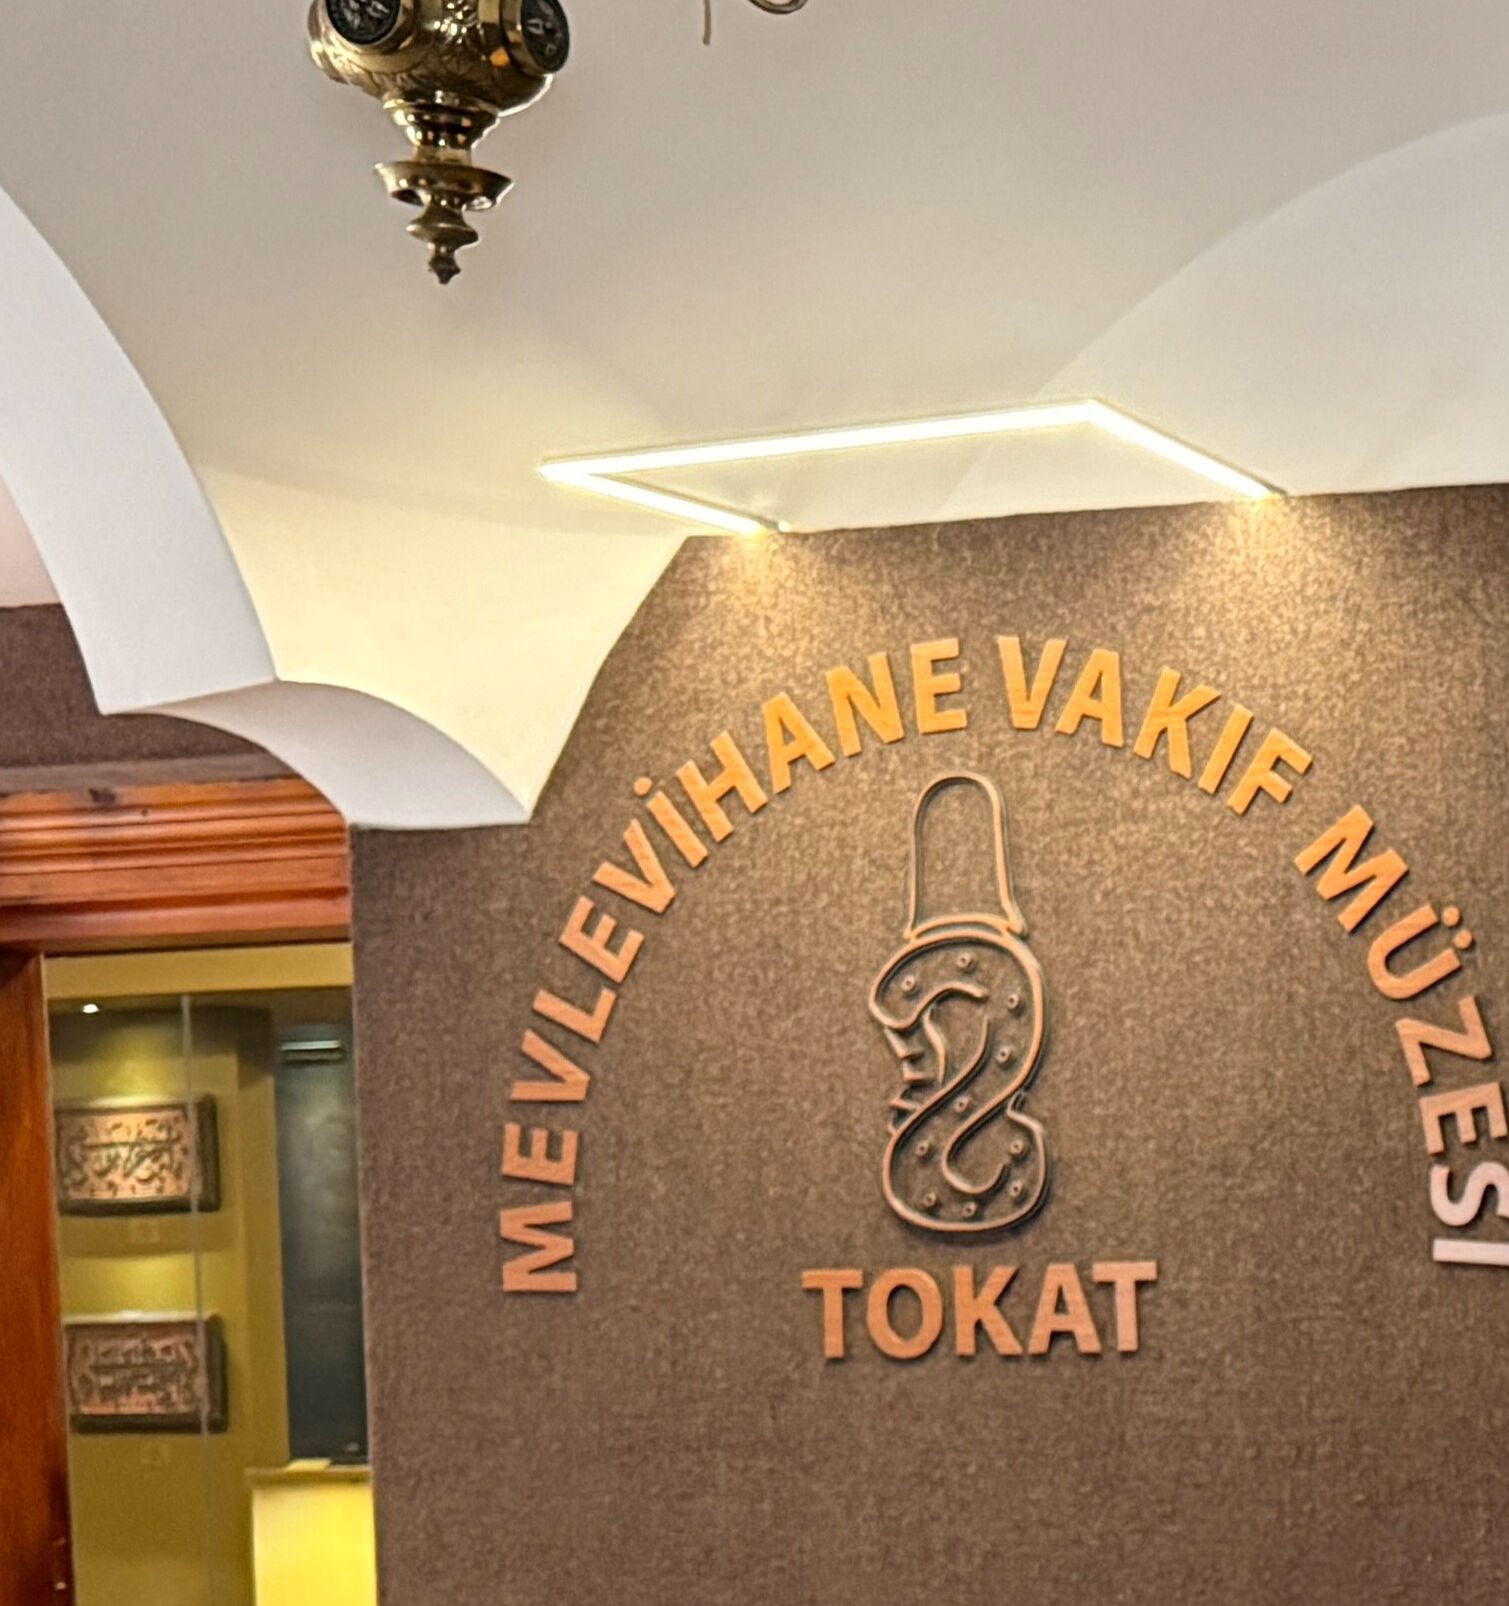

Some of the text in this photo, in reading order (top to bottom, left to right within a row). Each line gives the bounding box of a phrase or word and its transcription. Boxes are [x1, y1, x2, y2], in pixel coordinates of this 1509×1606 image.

[499, 636, 968, 1294] MEVLEVİHANE
[996, 634, 1313, 816] VAKIF
[800, 1259, 1158, 1360] TOKAT
